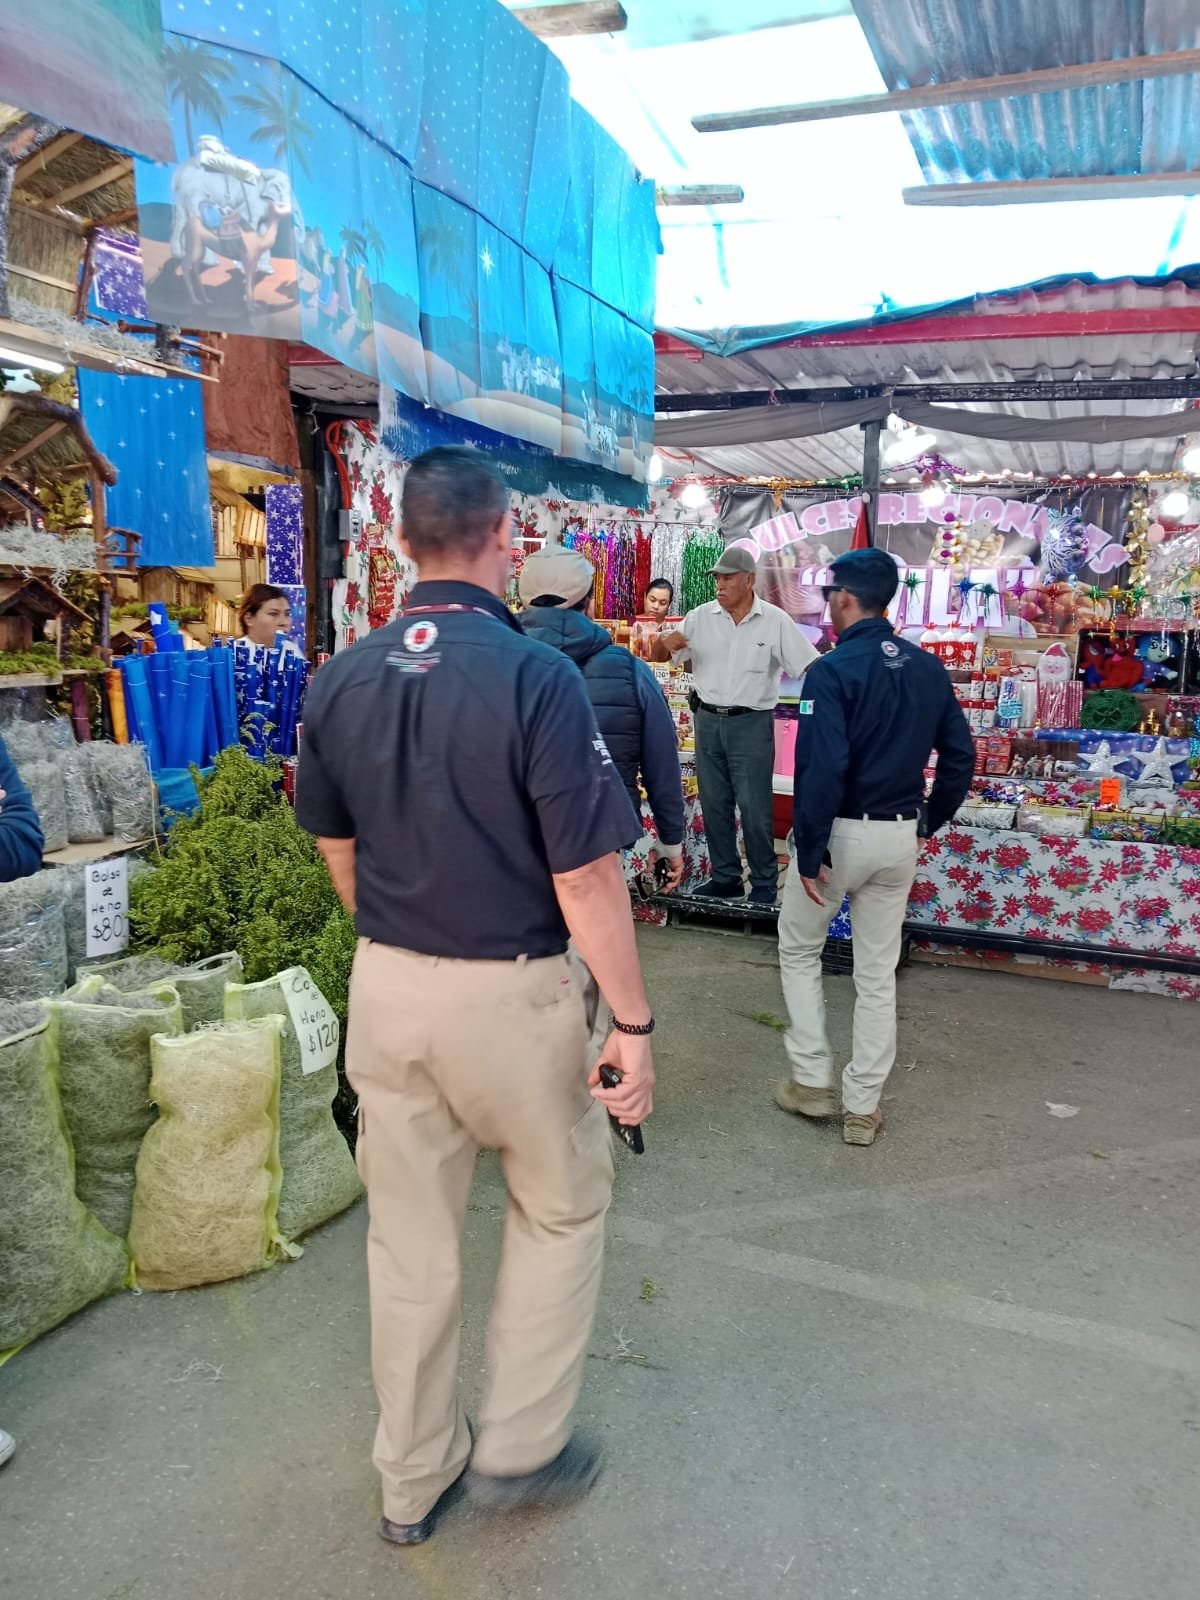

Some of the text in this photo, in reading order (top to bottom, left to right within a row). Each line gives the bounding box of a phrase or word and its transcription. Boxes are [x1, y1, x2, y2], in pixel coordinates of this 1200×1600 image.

[91, 868, 121, 883] Bolsa
[91, 901, 121, 915] Heno
[91, 915, 123, 941] $80
[301, 1009, 326, 1025] Heno
[308, 1020, 338, 1055] $120
